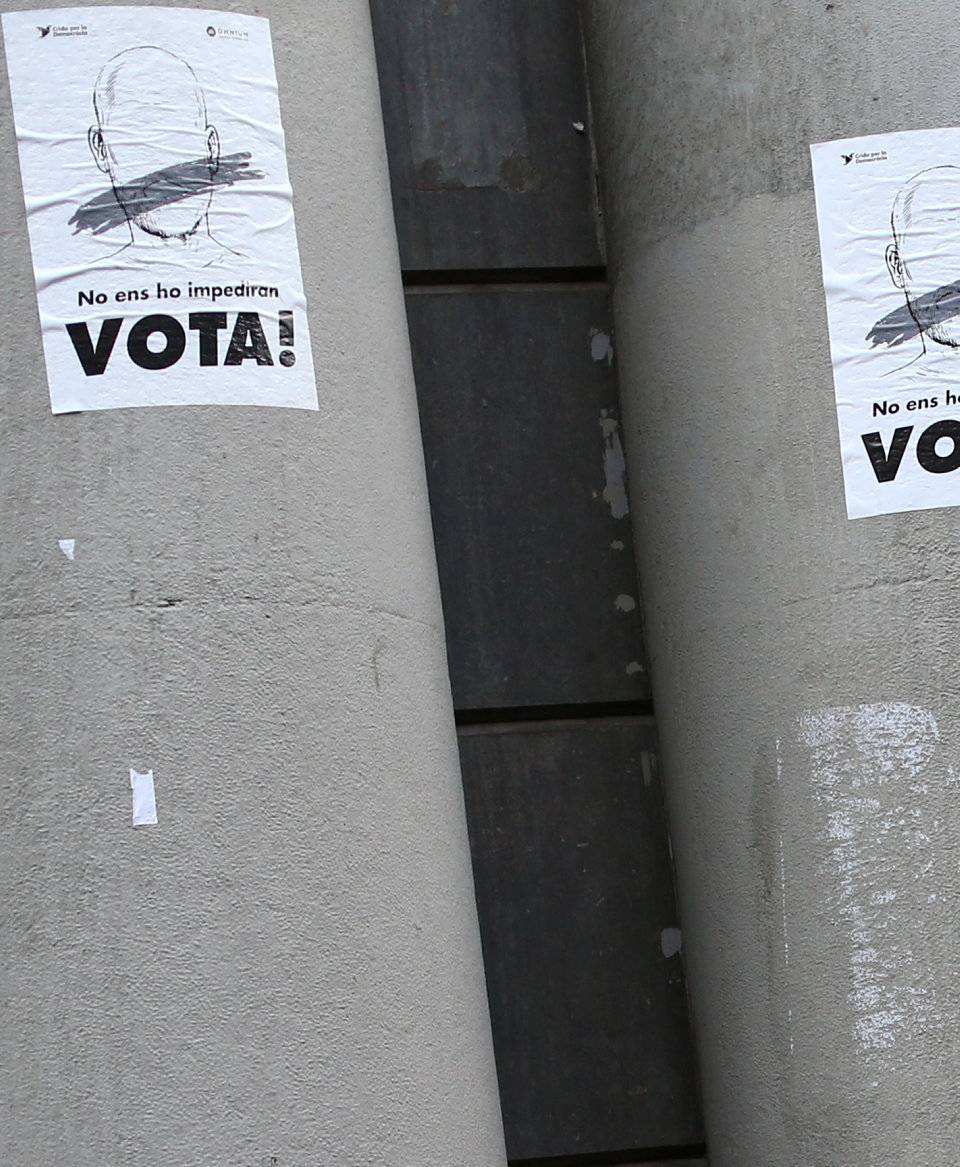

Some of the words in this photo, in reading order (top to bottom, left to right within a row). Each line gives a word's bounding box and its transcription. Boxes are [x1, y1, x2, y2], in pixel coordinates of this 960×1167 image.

[78, 290, 108, 306] No
[115, 289, 149, 302] ens
[157, 283, 181, 299] ho
[188, 281, 279, 302] impediran
[65, 310, 296, 376] VOTA!
[873, 401, 900, 417] No
[906, 397, 938, 411] ens
